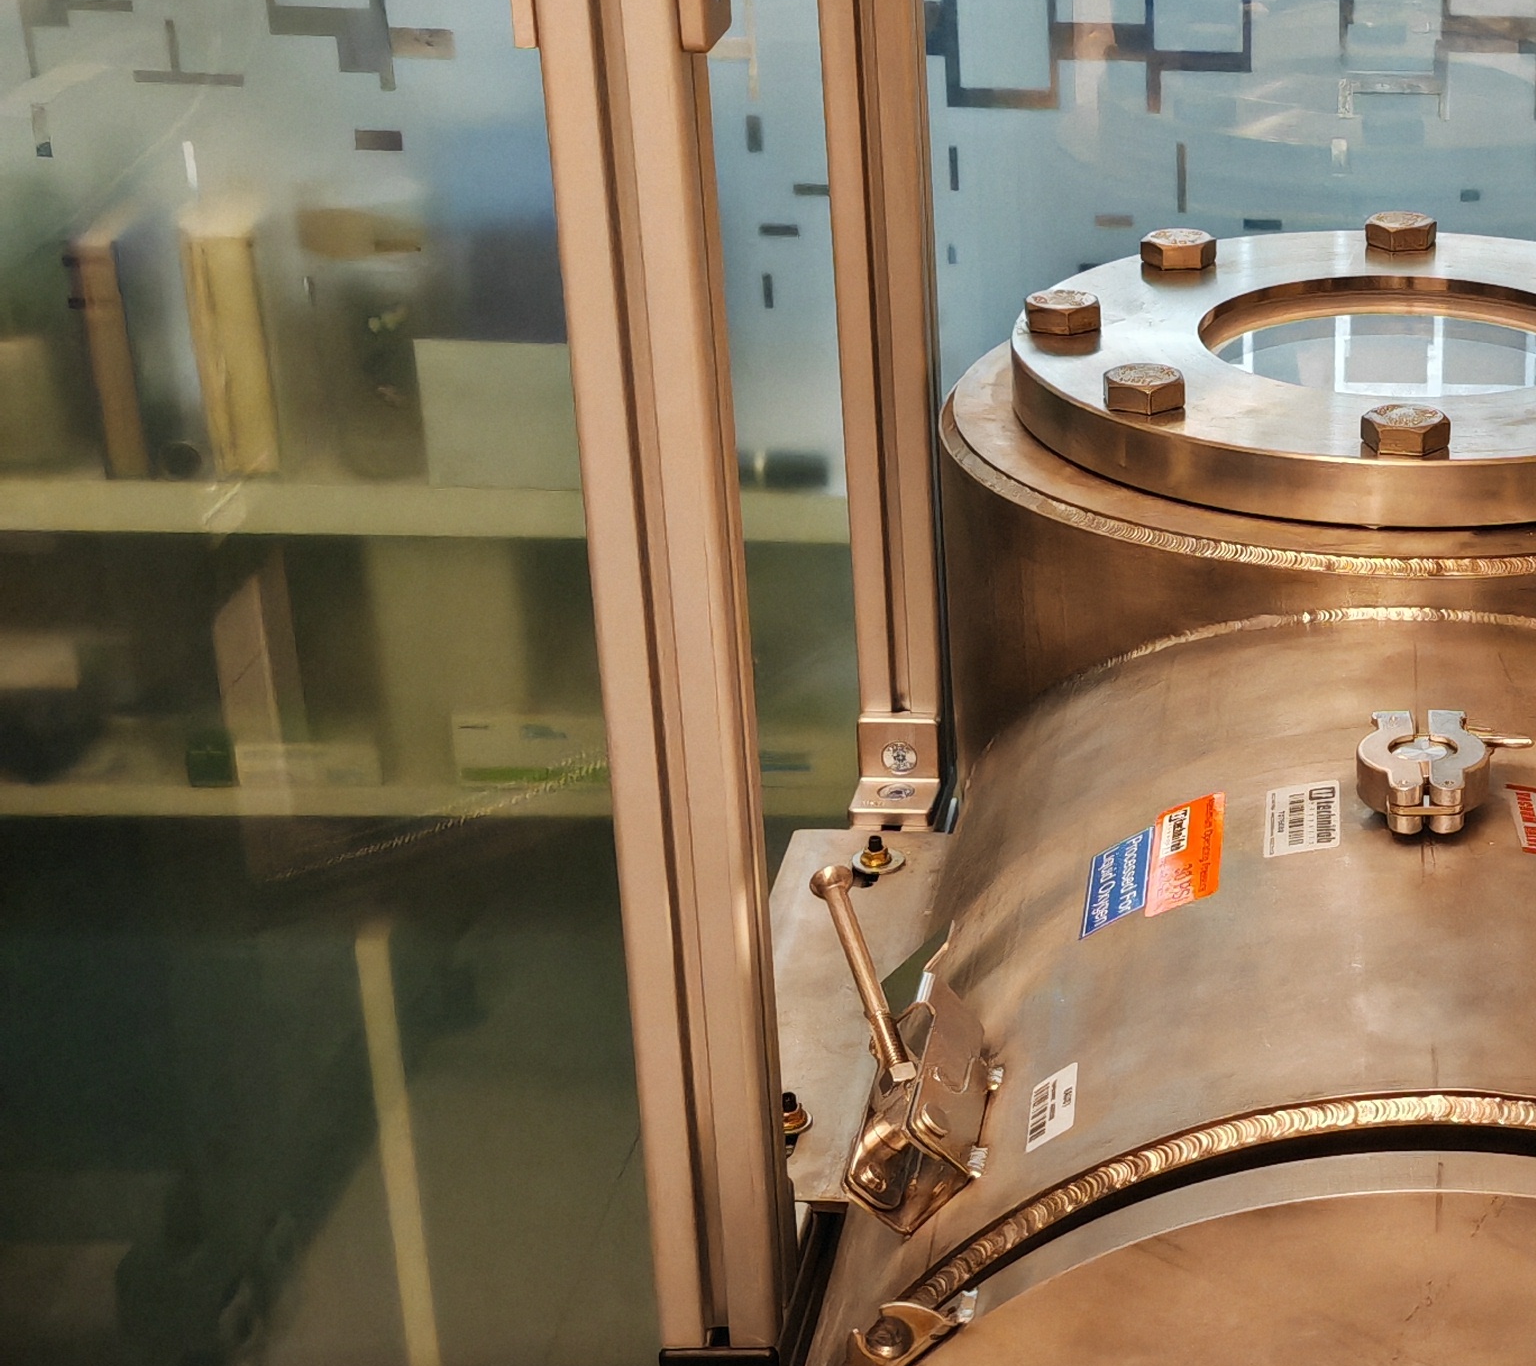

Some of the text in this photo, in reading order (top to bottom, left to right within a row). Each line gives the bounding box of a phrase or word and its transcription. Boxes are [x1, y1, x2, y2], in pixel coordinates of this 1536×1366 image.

[1091, 846, 1120, 927] Liquid Oxygen
[1117, 834, 1143, 915] Processed For
